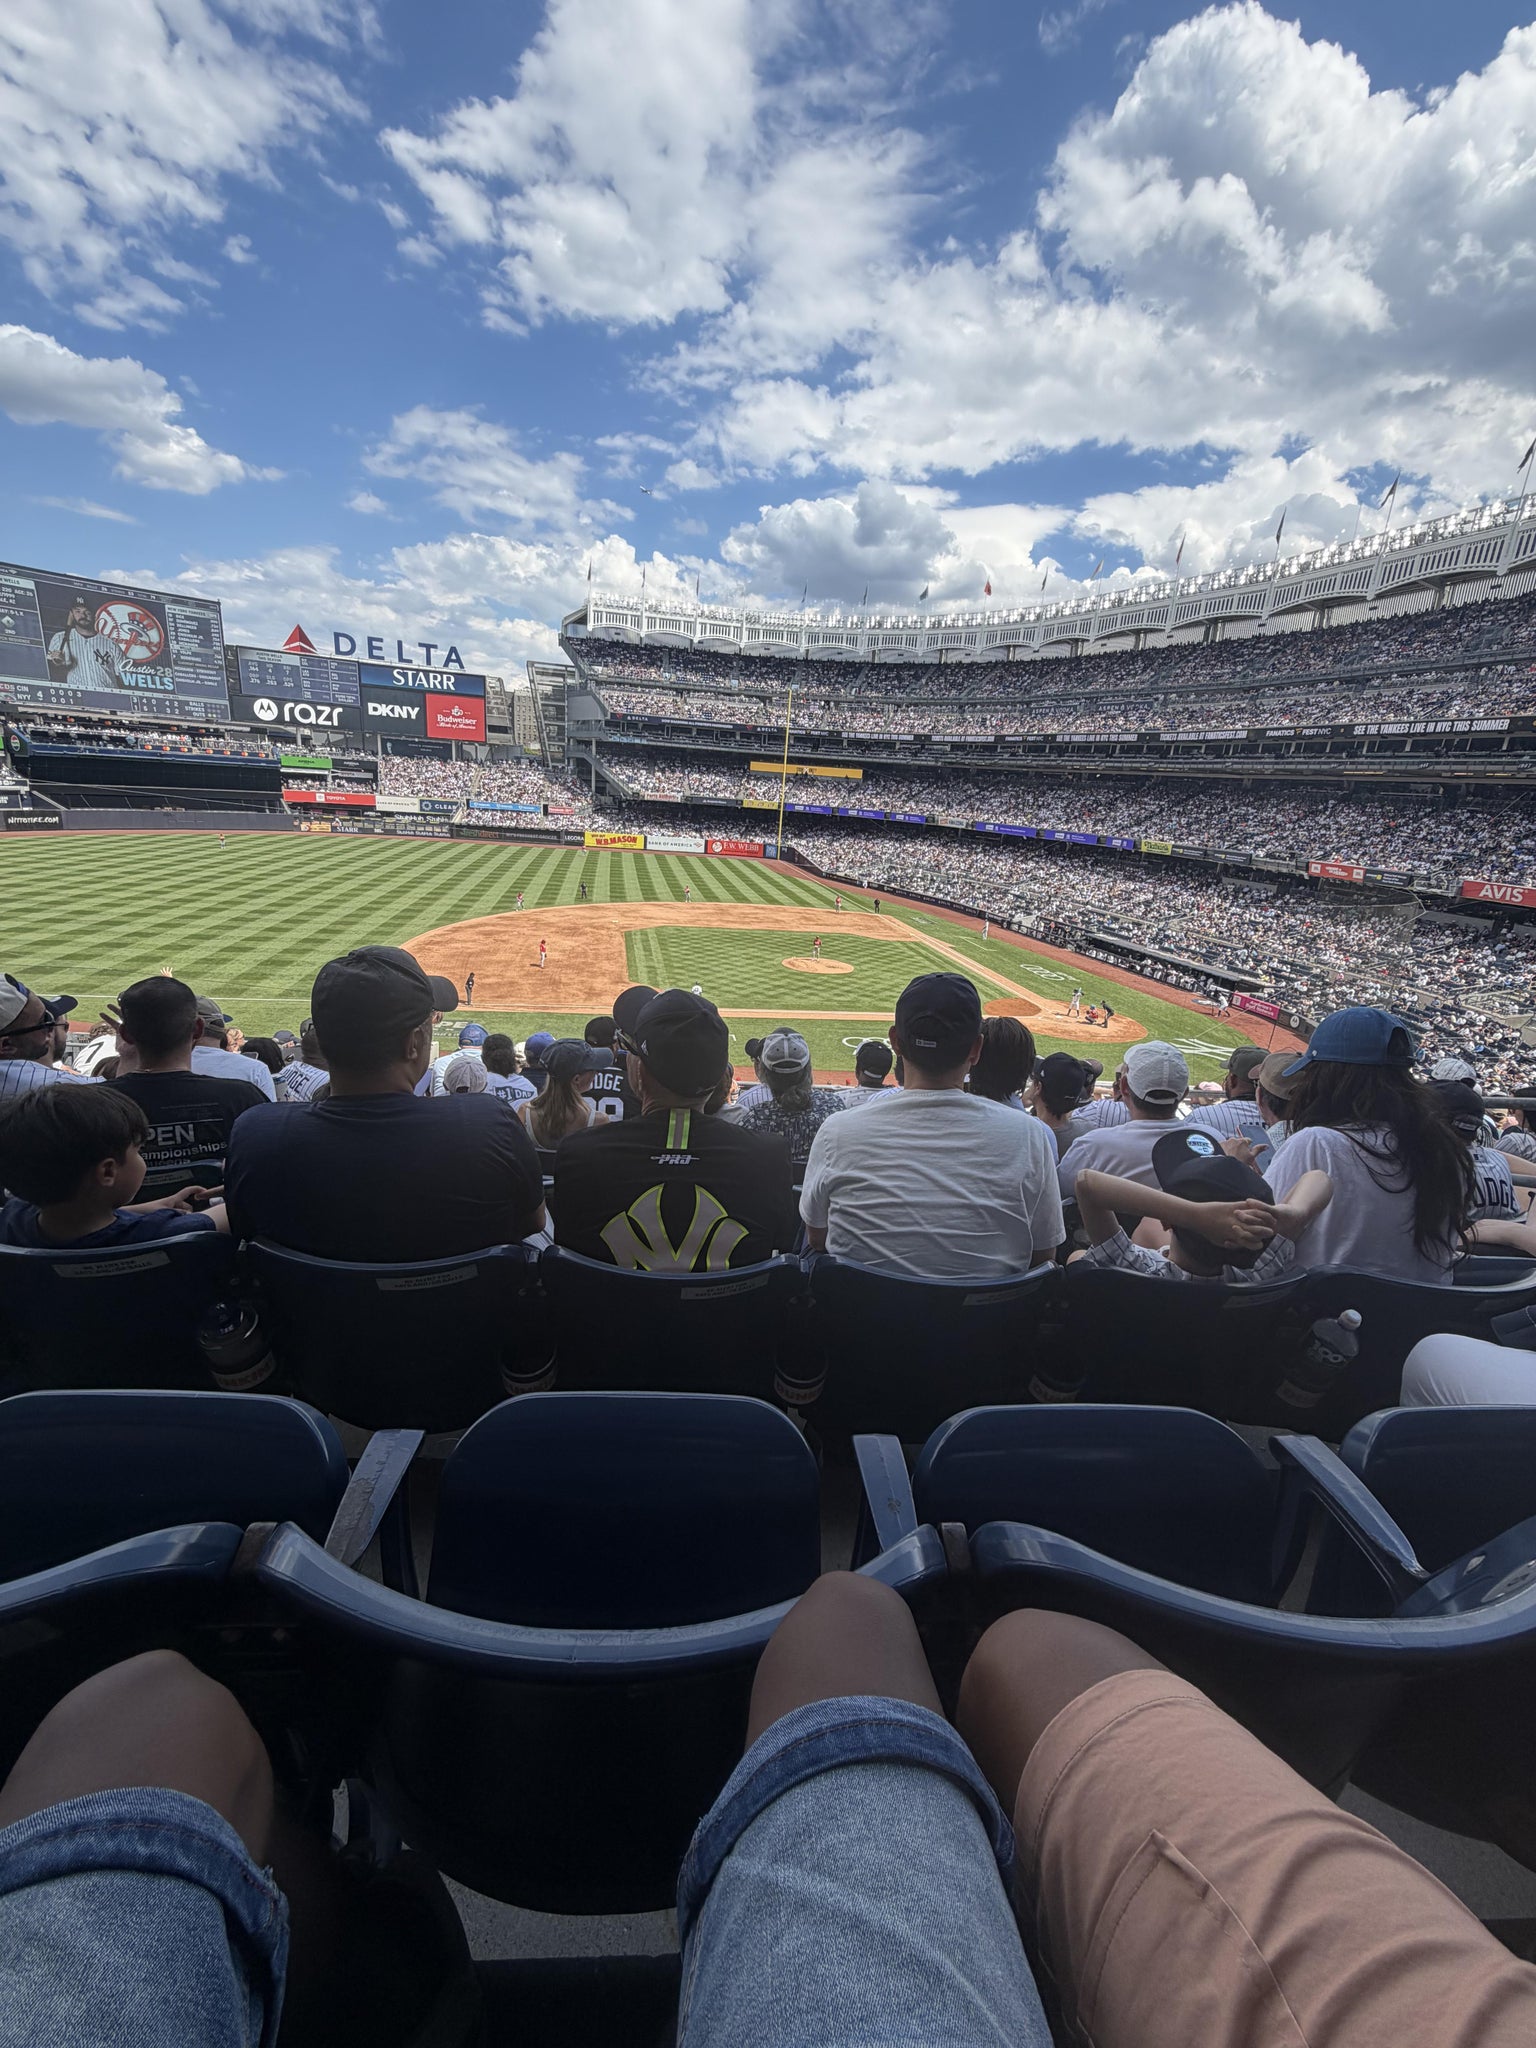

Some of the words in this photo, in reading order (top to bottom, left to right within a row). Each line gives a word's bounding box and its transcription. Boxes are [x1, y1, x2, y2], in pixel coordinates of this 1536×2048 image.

[333, 631, 465, 669] DELTA
[119, 659, 156, 674] Austin
[156, 666, 172, 677] 28
[120, 672, 174, 690] WELLS
[392, 669, 456, 691] STARR
[284, 702, 343, 726] razr
[367, 702, 420, 720] DKNY
[437, 714, 477, 724] Budweiser
[1199, 732, 1205, 740] AT
[1301, 728, 1318, 736] FEST
[1353, 725, 1366, 735] SEE
[1366, 724, 1379, 735] THE
[1380, 723, 1409, 734] YANKEES
[1410, 723, 1426, 733] LIVE
[1426, 722, 1435, 733] IN
[1436, 722, 1452, 732] NYC
[1453, 721, 1470, 731] THIS
[1471, 719, 1510, 731] SUMMER
[8, 816, 59, 824] NITTOTIRE.COM
[394, 814, 424, 822] StubHub
[738, 843, 759, 851] WEBB
[1479, 884, 1524, 902] AVIS
[590, 1072, 624, 1092] DGE
[498, 1086, 512, 1098] #1
[141, 1142, 228, 1160] ampionships
